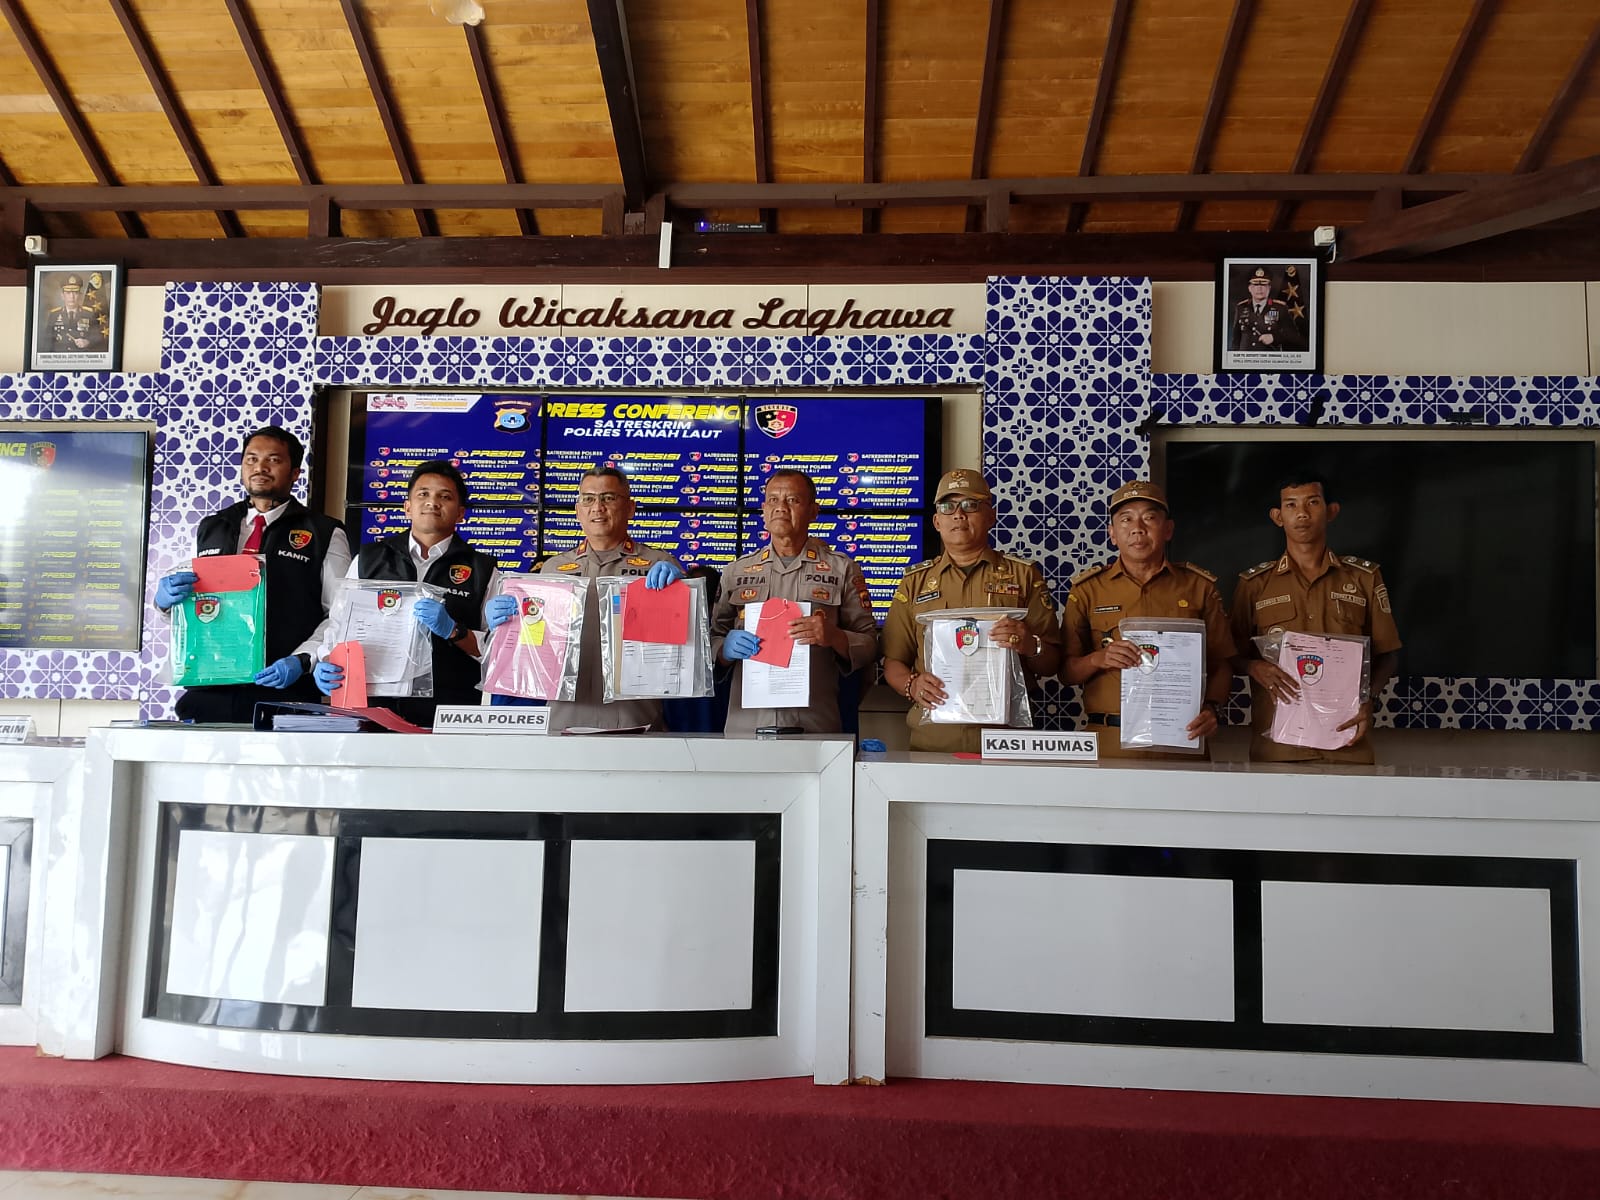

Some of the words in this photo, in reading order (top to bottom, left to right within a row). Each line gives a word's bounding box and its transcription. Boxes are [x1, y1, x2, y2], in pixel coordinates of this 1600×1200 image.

[363, 296, 481, 335] Joglo
[499, 296, 735, 328] Wicaksana
[743, 297, 955, 336] Laghawa
[594, 420, 692, 429] SATRESKRIM
[564, 427, 621, 437] POLRES
[625, 428, 680, 438] TANAH
[682, 430, 722, 438] LAUT
[278, 550, 311, 563] KANIT
[736, 576, 766, 585] SETIA
[805, 574, 839, 586] POLRI
[440, 713, 483, 724] WAKA
[488, 714, 546, 725] POLRES
[986, 738, 1026, 751] KASI
[1032, 740, 1094, 752] HUMAS
